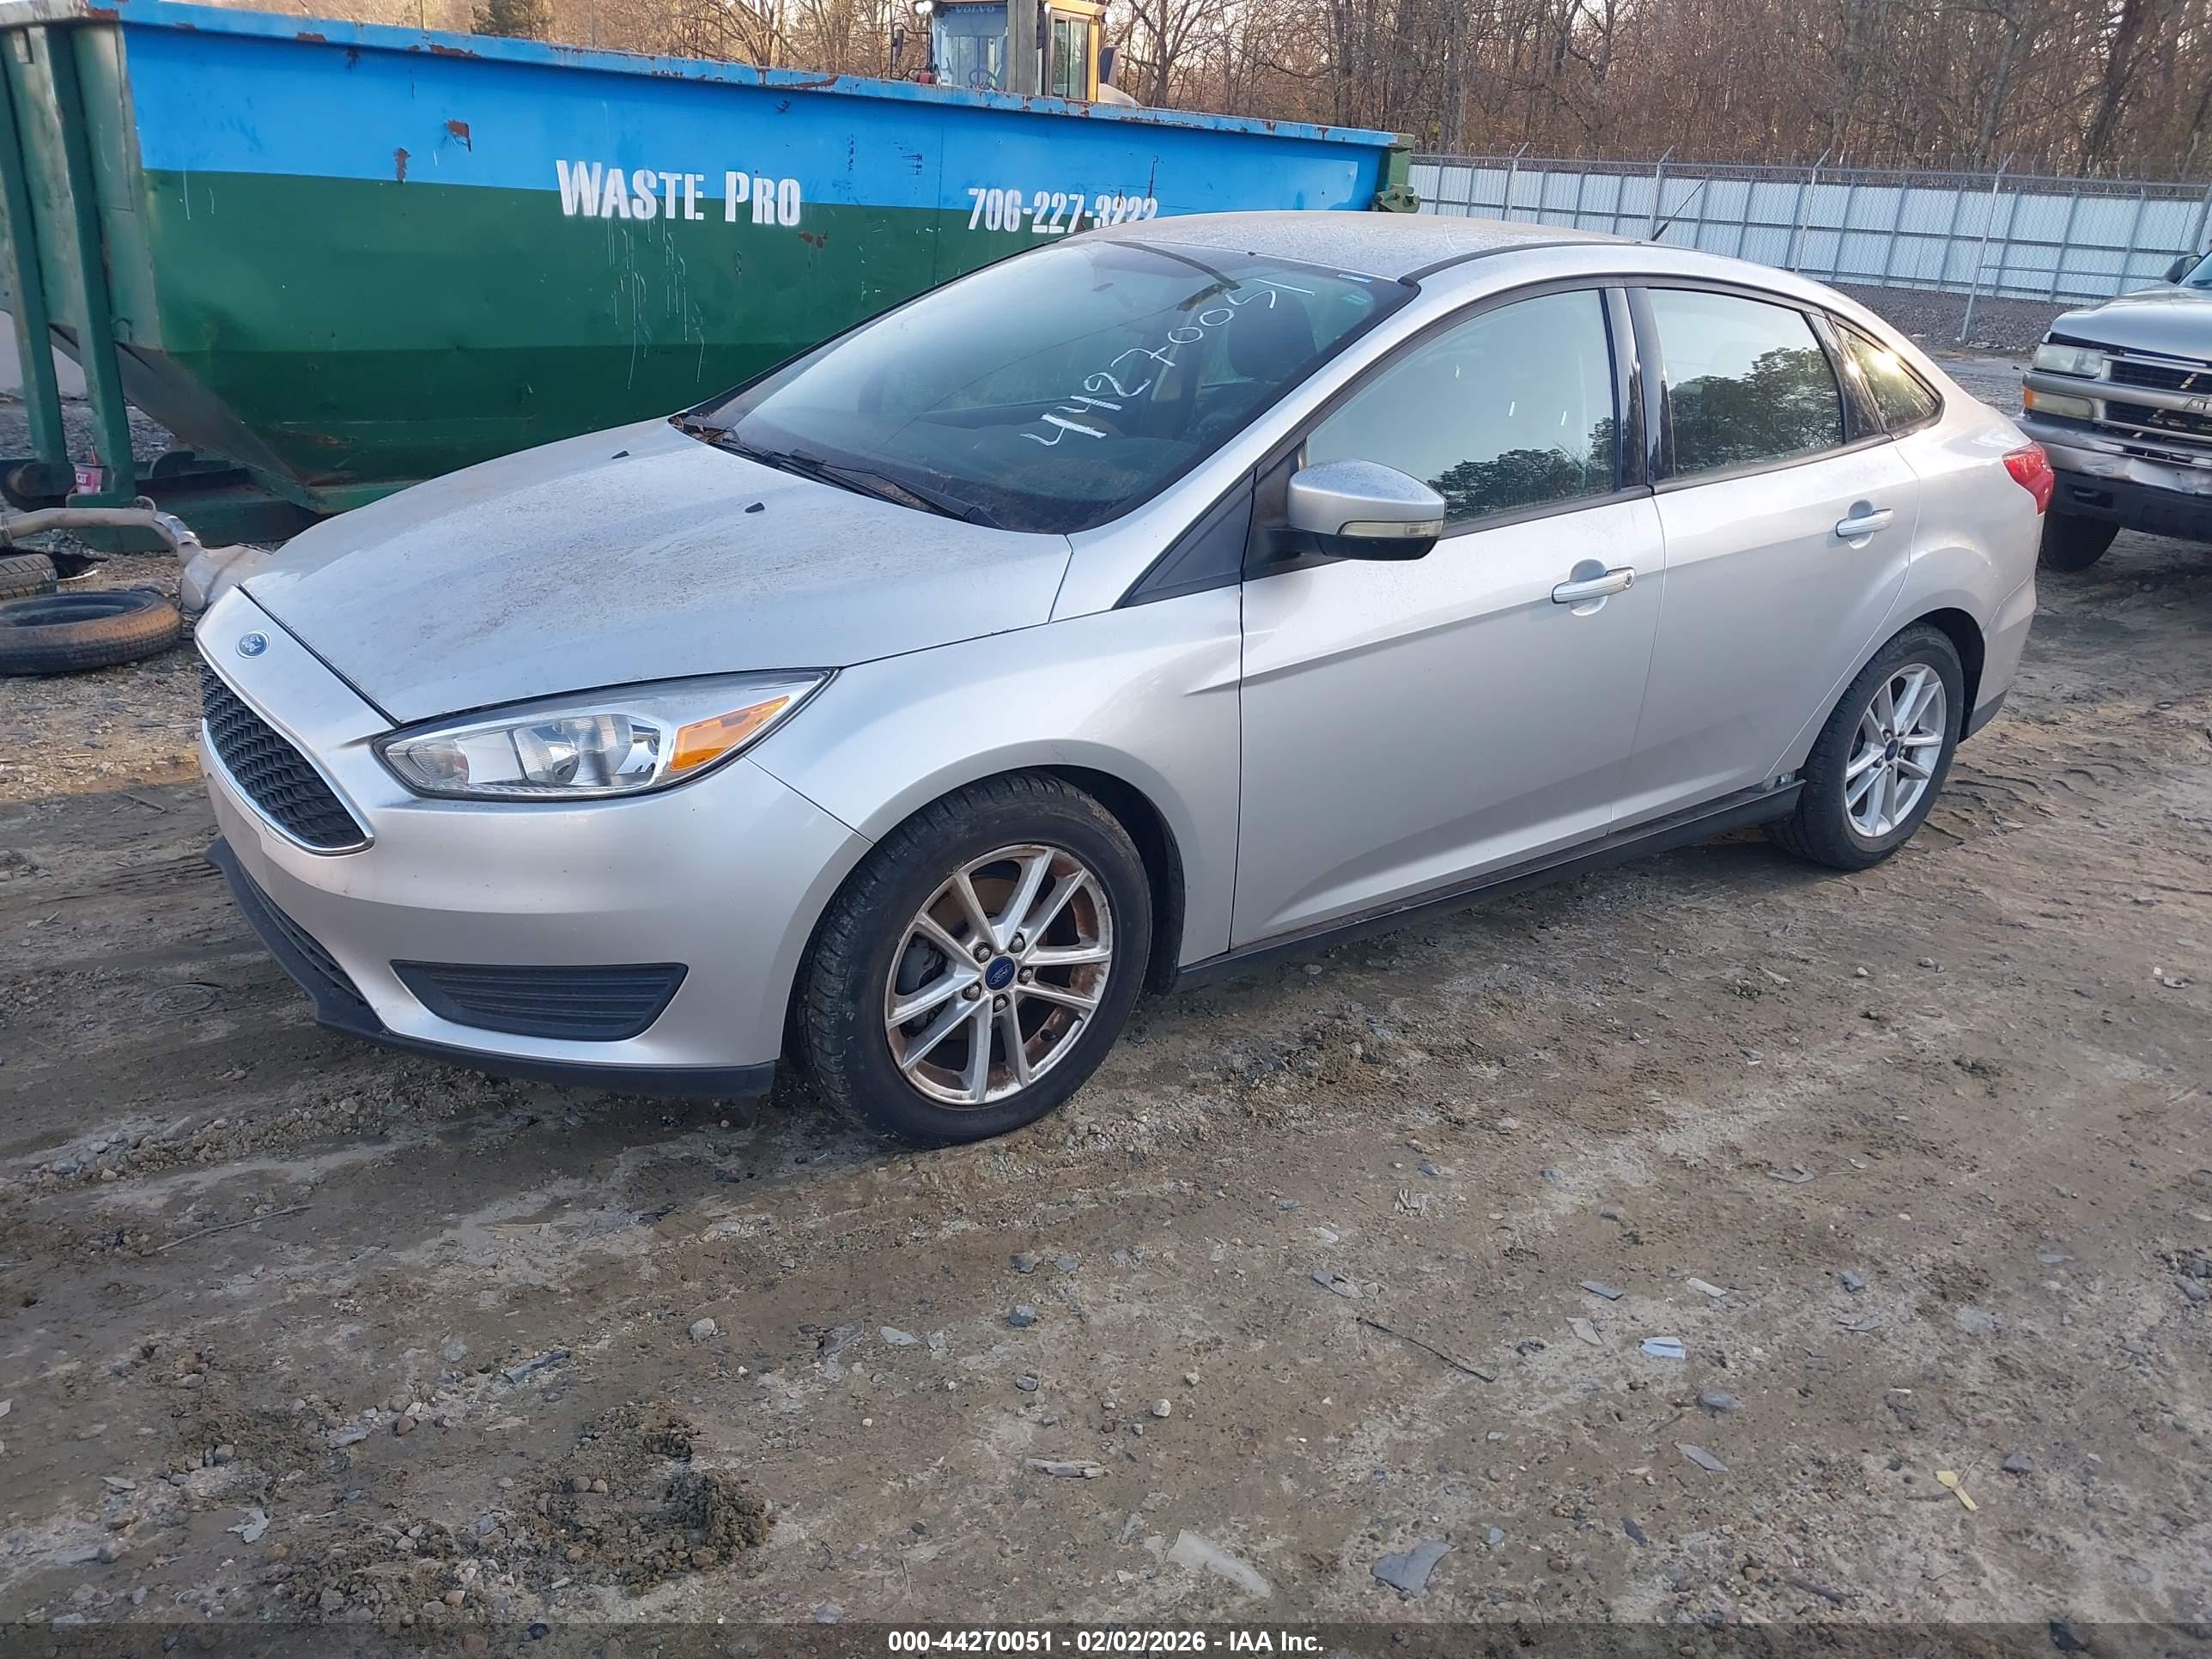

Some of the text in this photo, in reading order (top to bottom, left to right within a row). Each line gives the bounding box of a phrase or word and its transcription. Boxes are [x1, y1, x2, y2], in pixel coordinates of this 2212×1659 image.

[955, 5, 995, 14] VOLVO
[556, 160, 801, 227] WASTE PRO
[1019, 277, 1316, 447] 44270051
